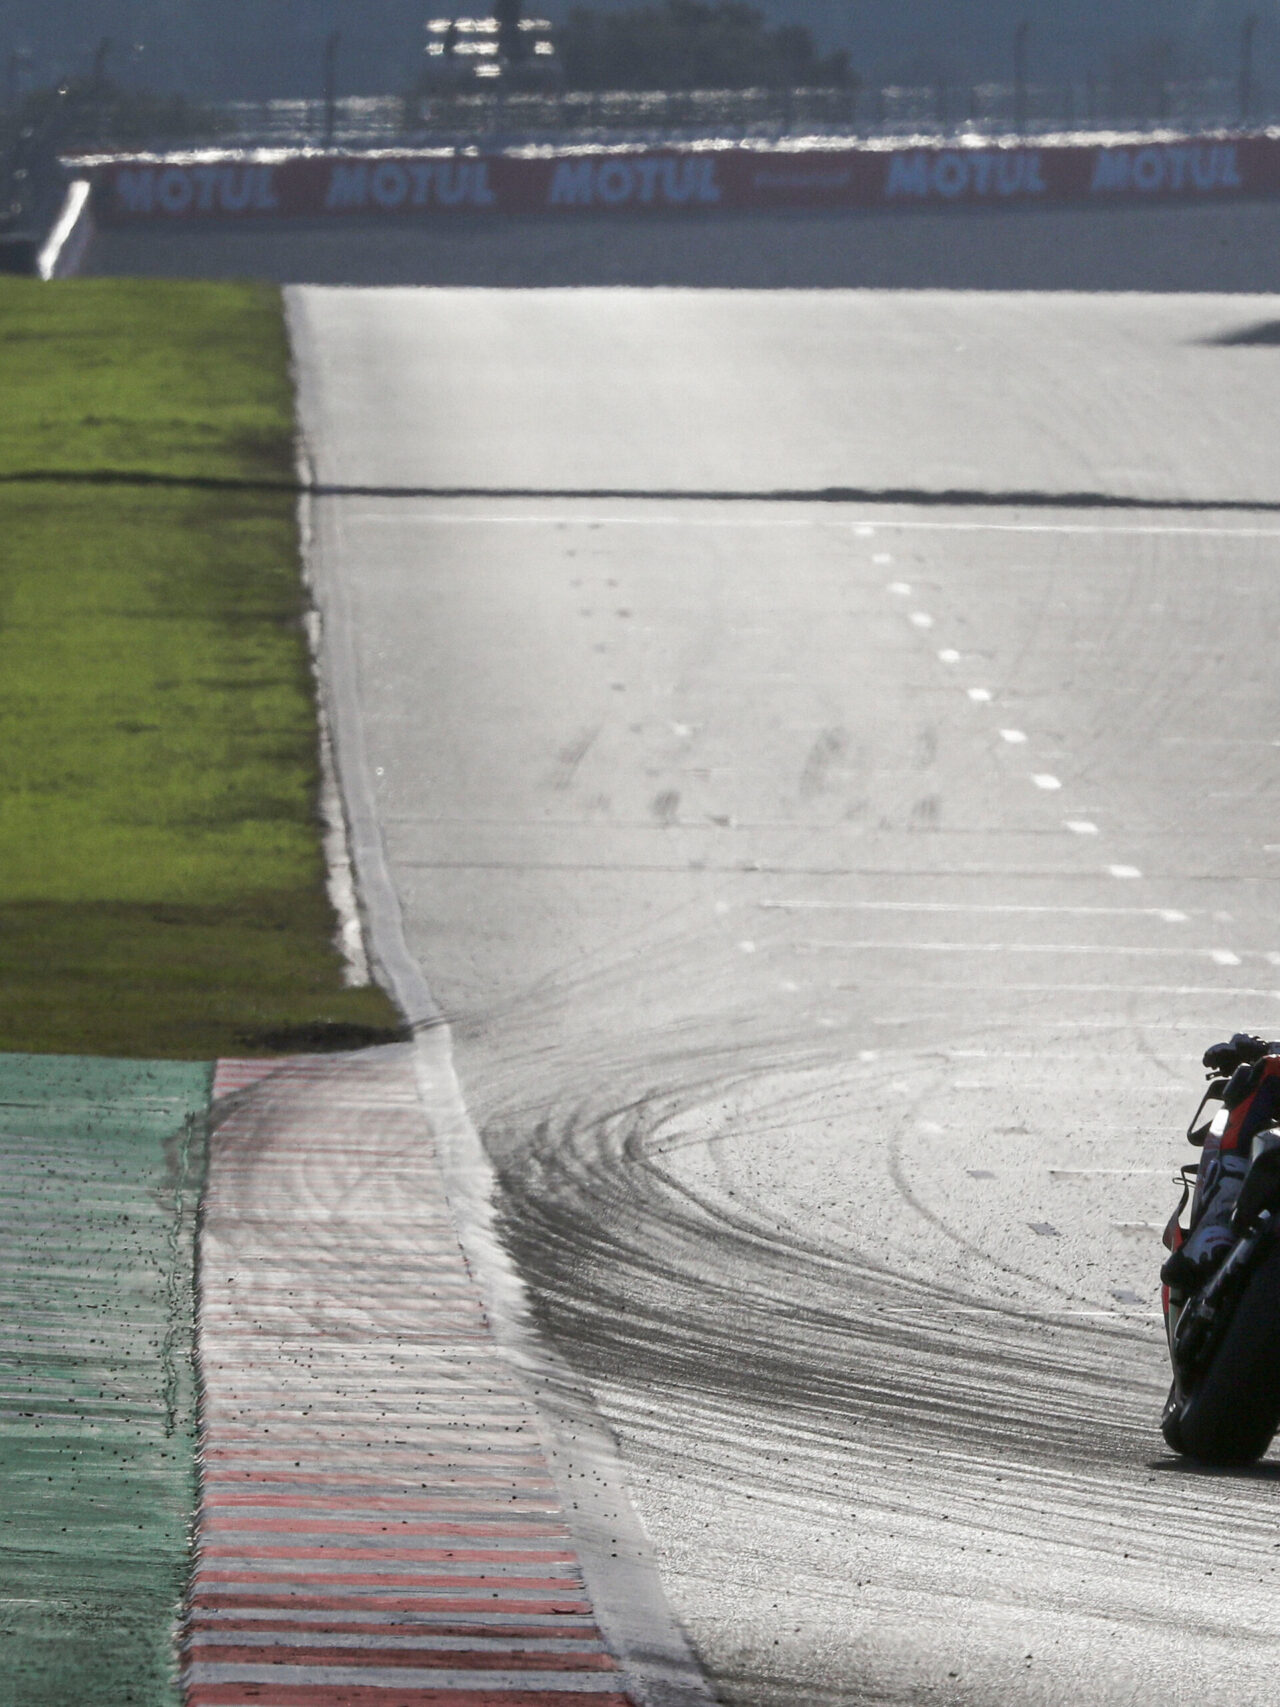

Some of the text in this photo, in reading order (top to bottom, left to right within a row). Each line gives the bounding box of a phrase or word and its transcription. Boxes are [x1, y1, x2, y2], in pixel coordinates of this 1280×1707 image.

[114, 165, 278, 212] MOTUL
[326, 162, 493, 207] MOTUL
[549, 157, 721, 204] MOTUL
[885, 152, 1046, 198] MOTUL
[1091, 146, 1241, 190] MOTUL
